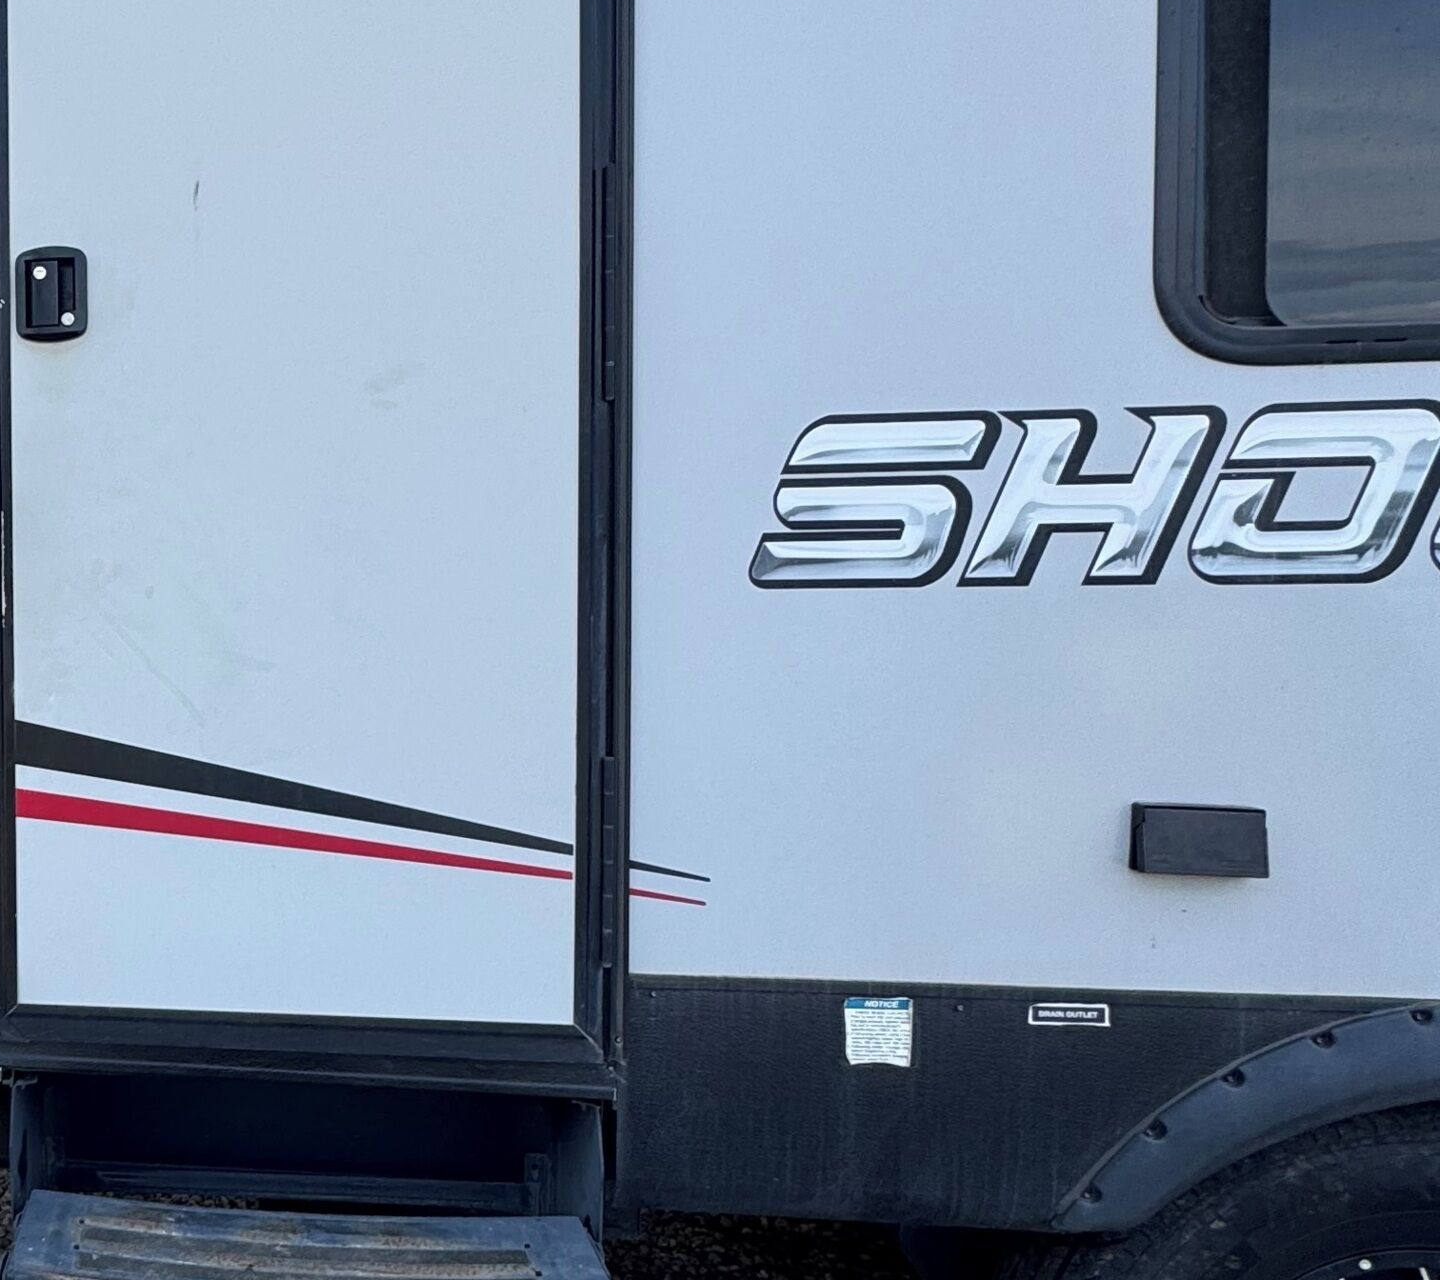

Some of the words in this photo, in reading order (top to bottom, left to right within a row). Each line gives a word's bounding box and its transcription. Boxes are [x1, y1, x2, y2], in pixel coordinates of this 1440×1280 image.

[748, 399, 1440, 589] SHO
[864, 1000, 899, 1009] NOTICE
[1038, 1010, 1065, 1018] DRAIN
[1066, 1011, 1098, 1019] OUTLET
